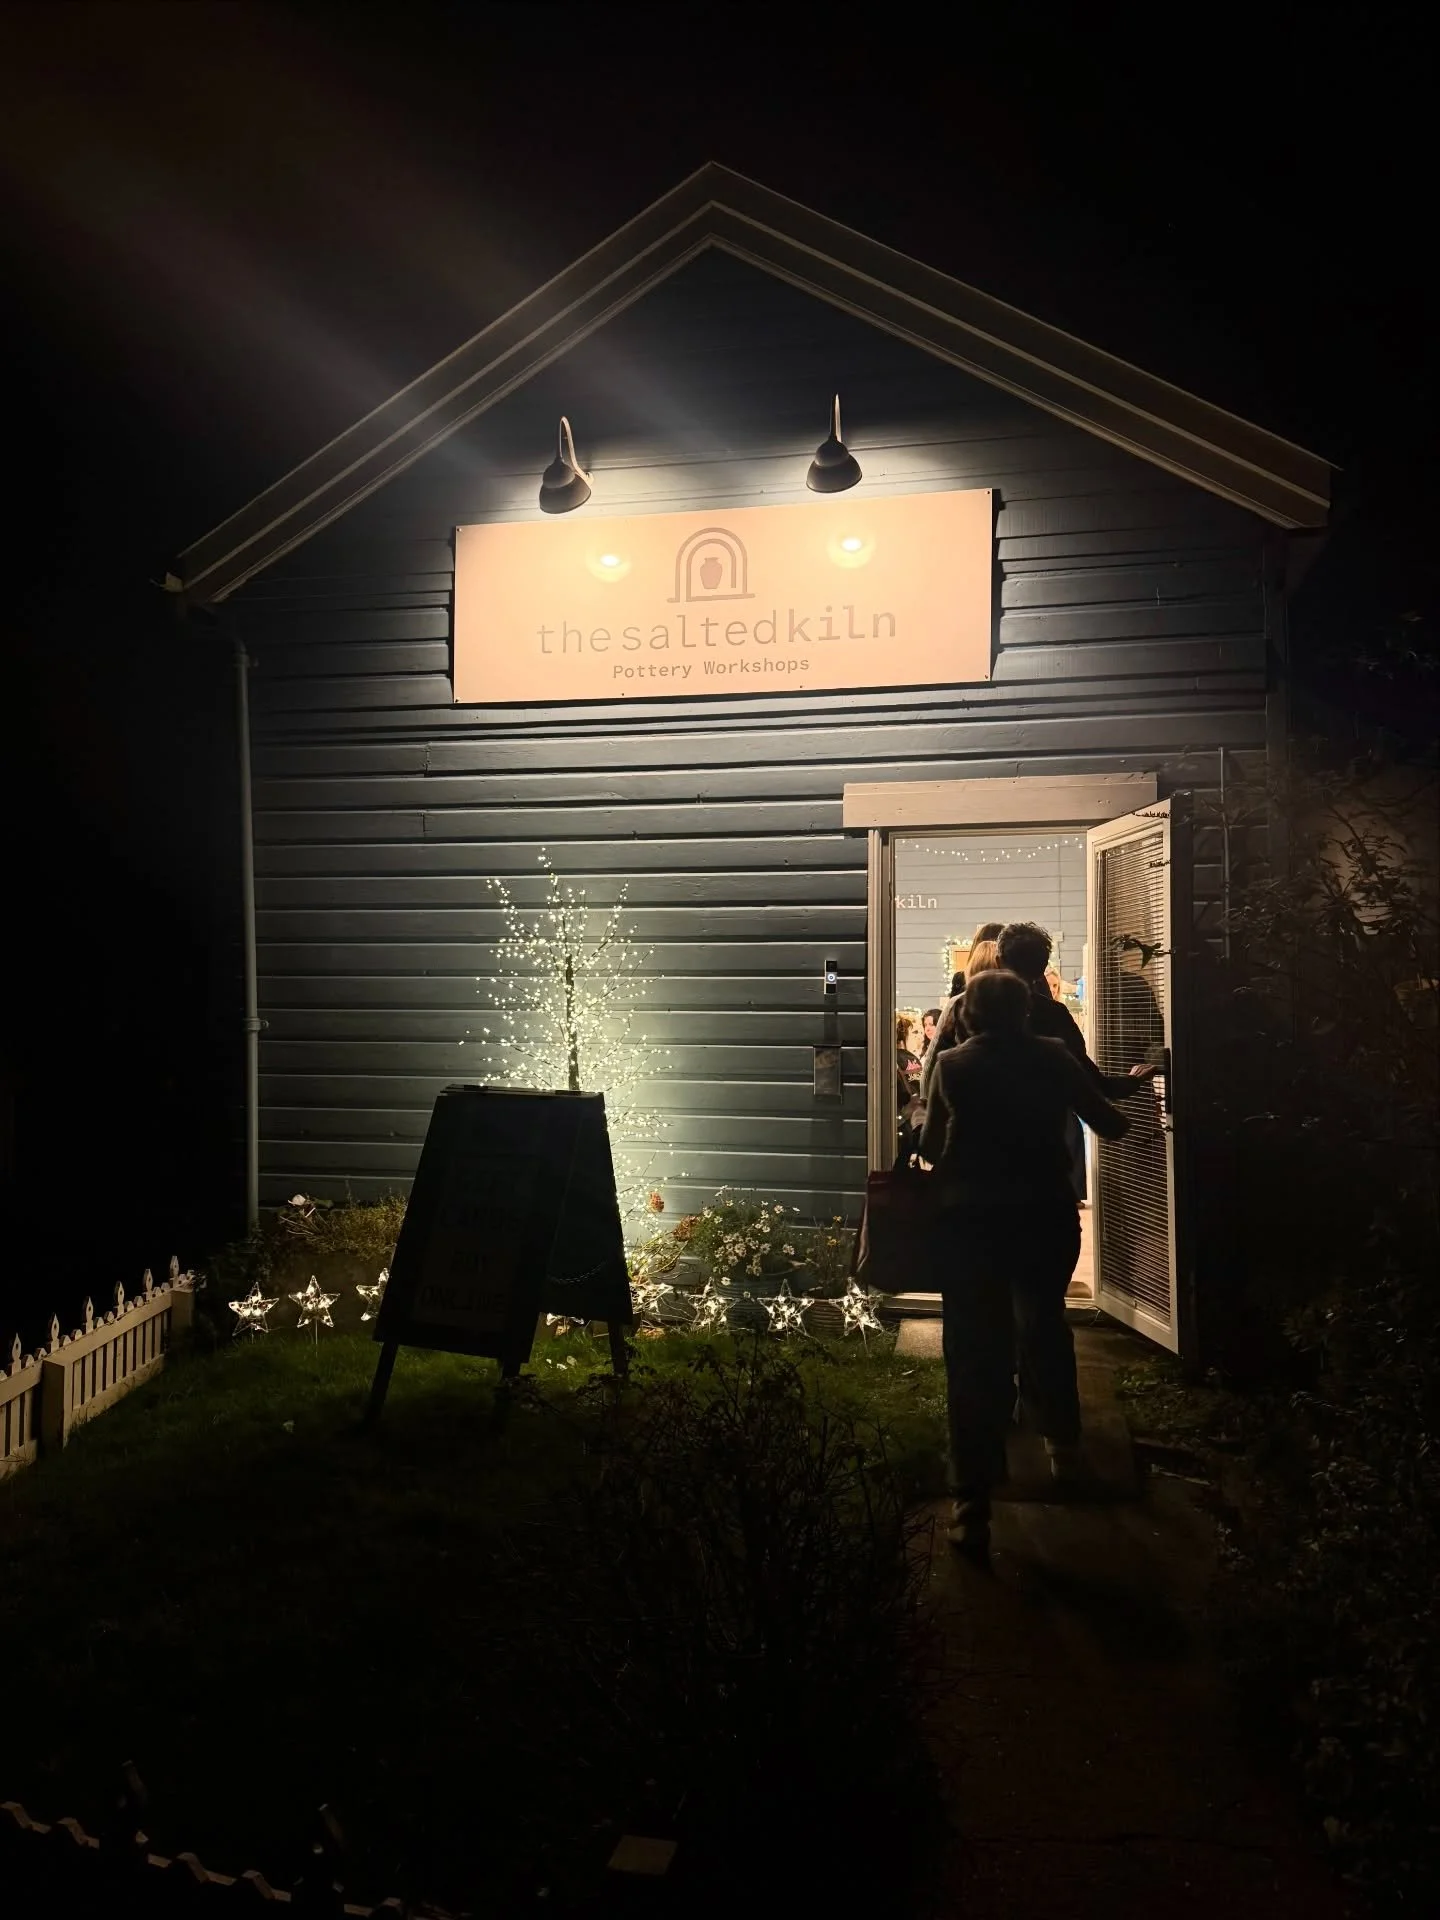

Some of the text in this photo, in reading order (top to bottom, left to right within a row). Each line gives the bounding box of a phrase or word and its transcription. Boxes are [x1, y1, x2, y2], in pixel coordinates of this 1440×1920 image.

[536, 604, 896, 654] thesaltedkiln
[612, 657, 810, 679] Pottery Workshops
[895, 894, 937, 909] kiln
